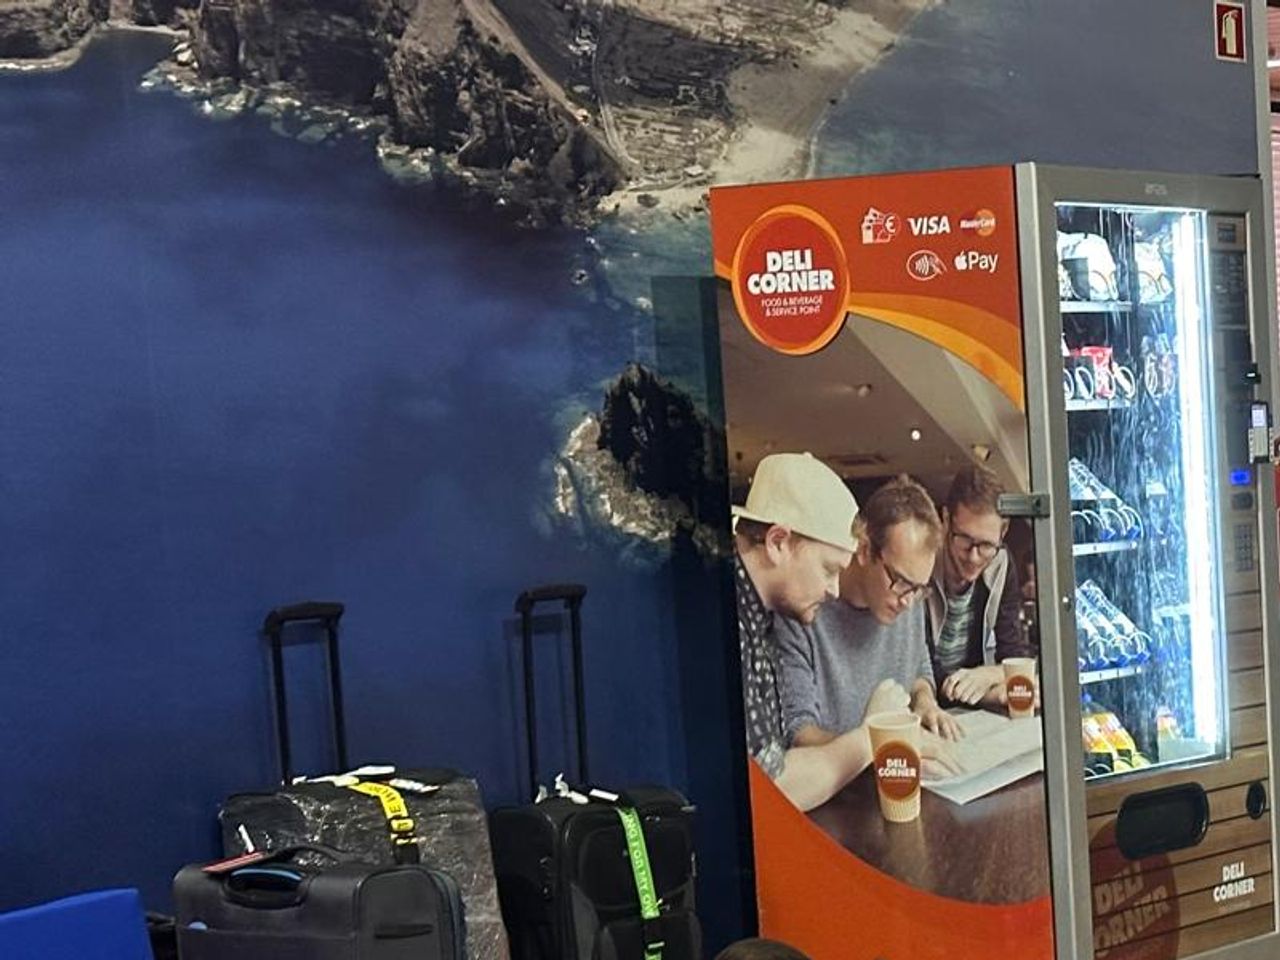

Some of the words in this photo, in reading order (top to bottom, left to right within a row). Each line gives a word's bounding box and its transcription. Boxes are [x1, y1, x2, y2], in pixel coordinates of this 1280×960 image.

[907, 215, 951, 236] VISA
[766, 248, 812, 272] DELI
[968, 251, 998, 273] Pay
[747, 268, 836, 295] CORNER
[878, 767, 917, 778] CORNER
[886, 758, 907, 768] DELI
[1222, 861, 1245, 882] DELI
[1095, 861, 1144, 914] DELI
[1213, 877, 1256, 902] CORNER
[1094, 885, 1172, 958] ORNER
